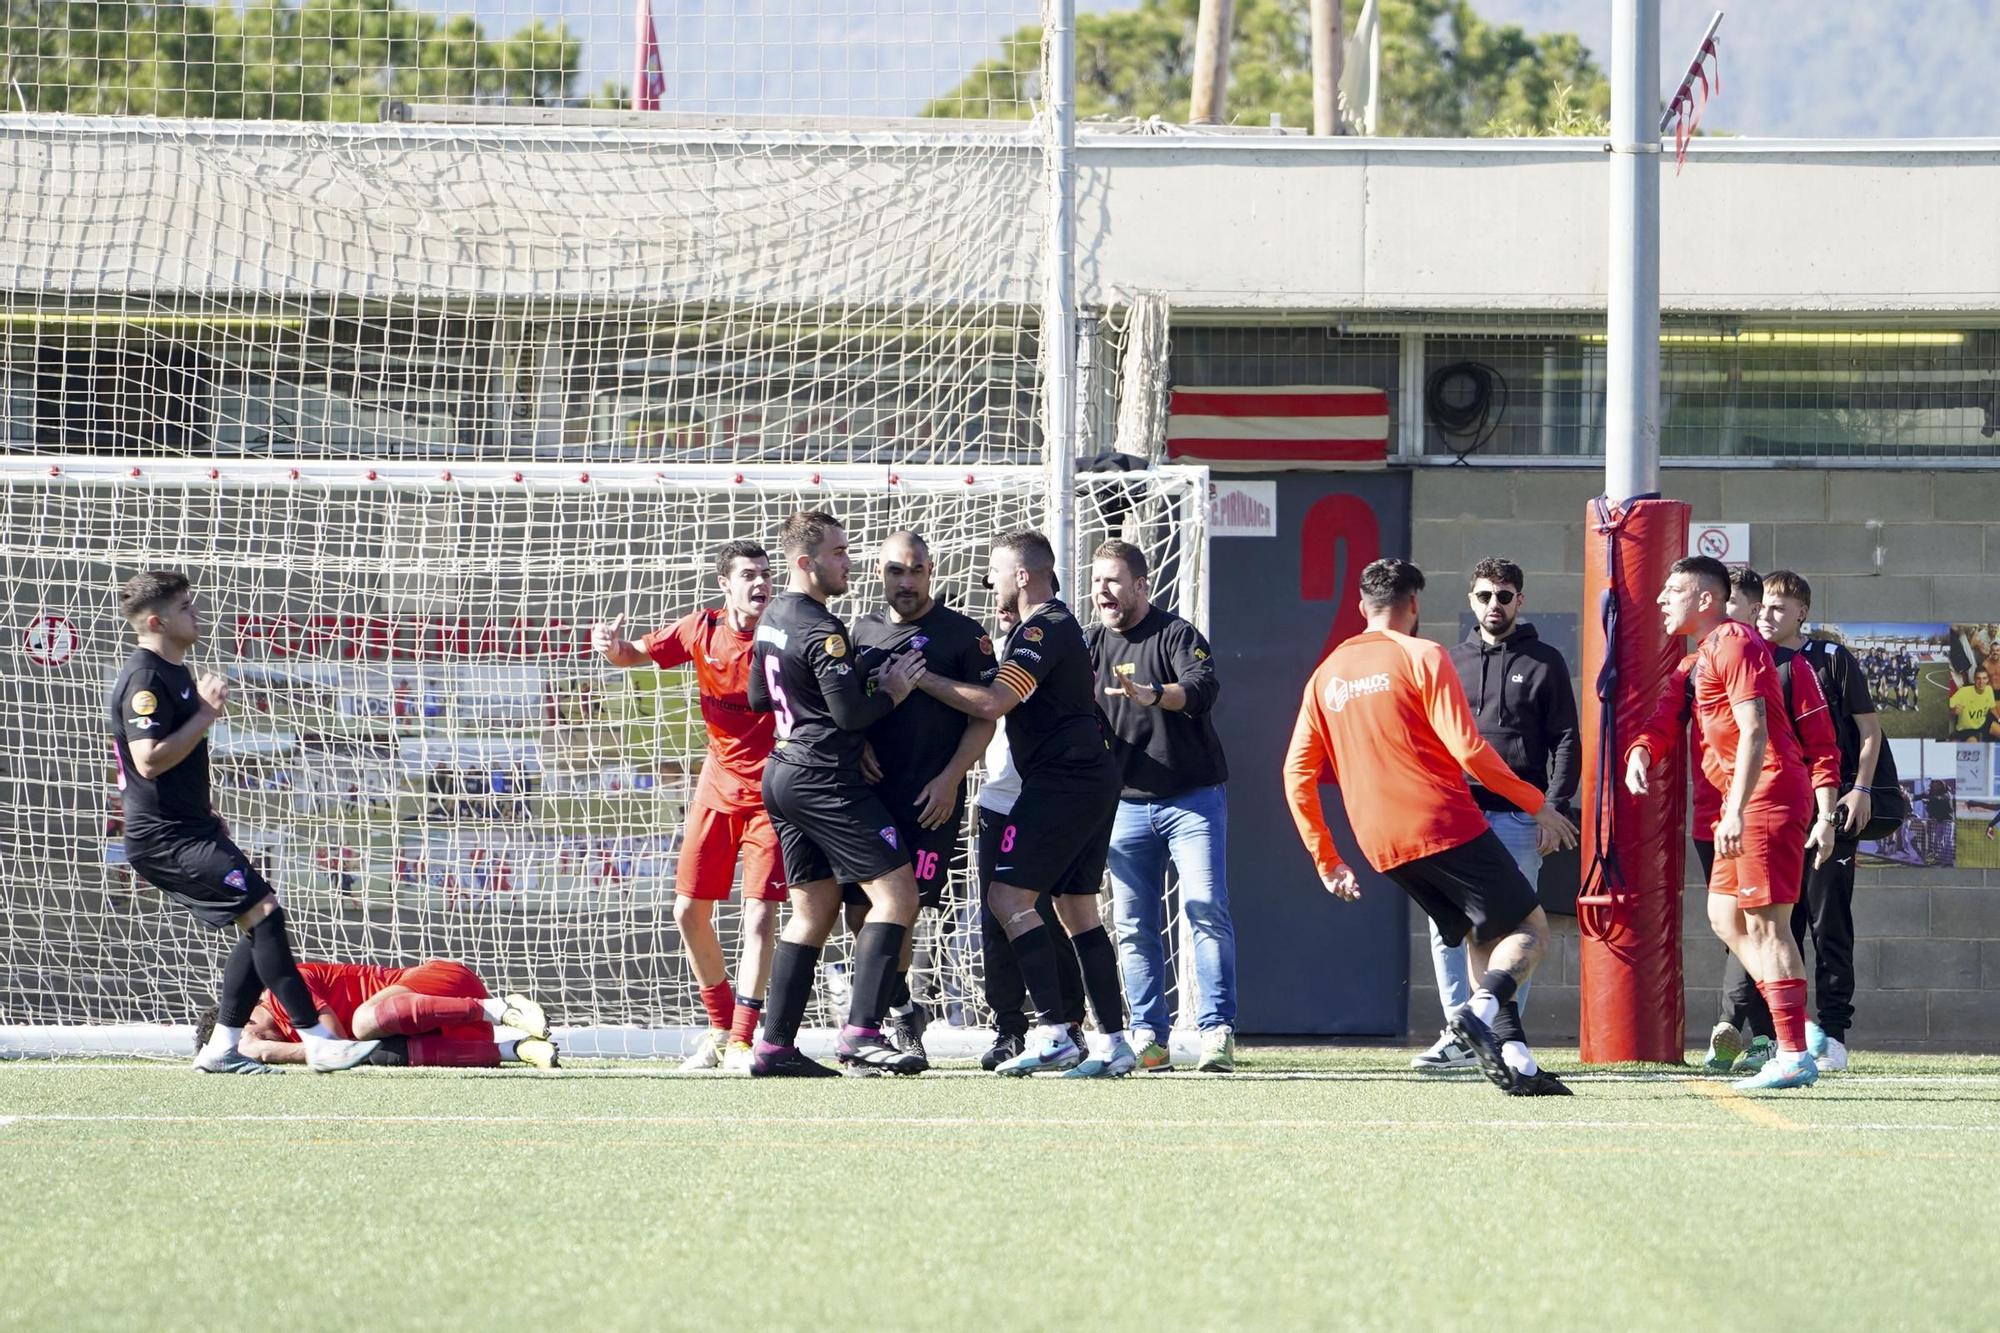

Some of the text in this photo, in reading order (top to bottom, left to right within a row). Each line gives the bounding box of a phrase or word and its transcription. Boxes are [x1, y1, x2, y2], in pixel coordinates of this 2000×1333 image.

[764, 654, 794, 738] 5
[1348, 672, 1390, 693] HALOS
[1000, 825, 1017, 853] 8
[915, 849, 939, 881] 16
